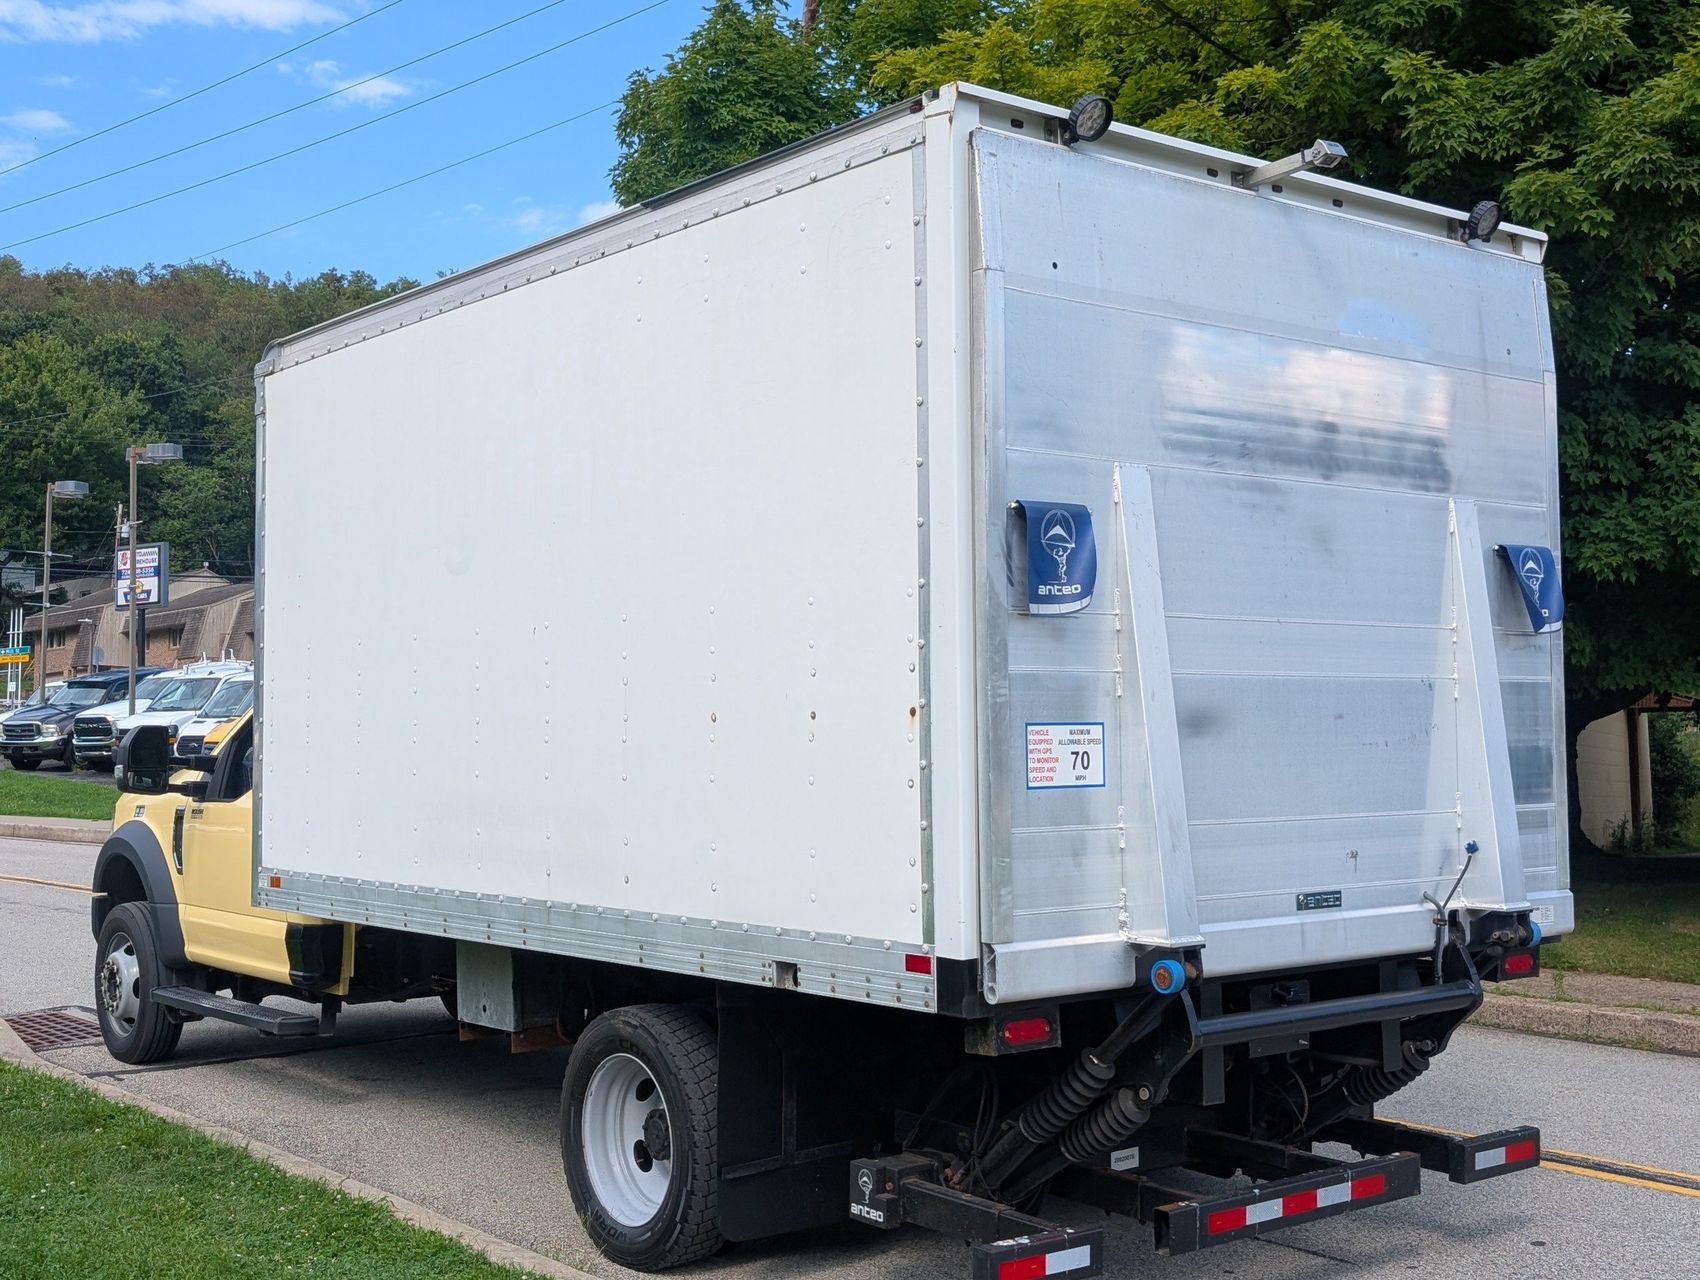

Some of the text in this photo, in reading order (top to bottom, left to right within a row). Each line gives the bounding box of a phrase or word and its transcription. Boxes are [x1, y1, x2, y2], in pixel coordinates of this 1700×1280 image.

[1038, 584, 1081, 595] anteo
[1070, 751, 1090, 770] 70
[851, 1203, 884, 1222] anteo
